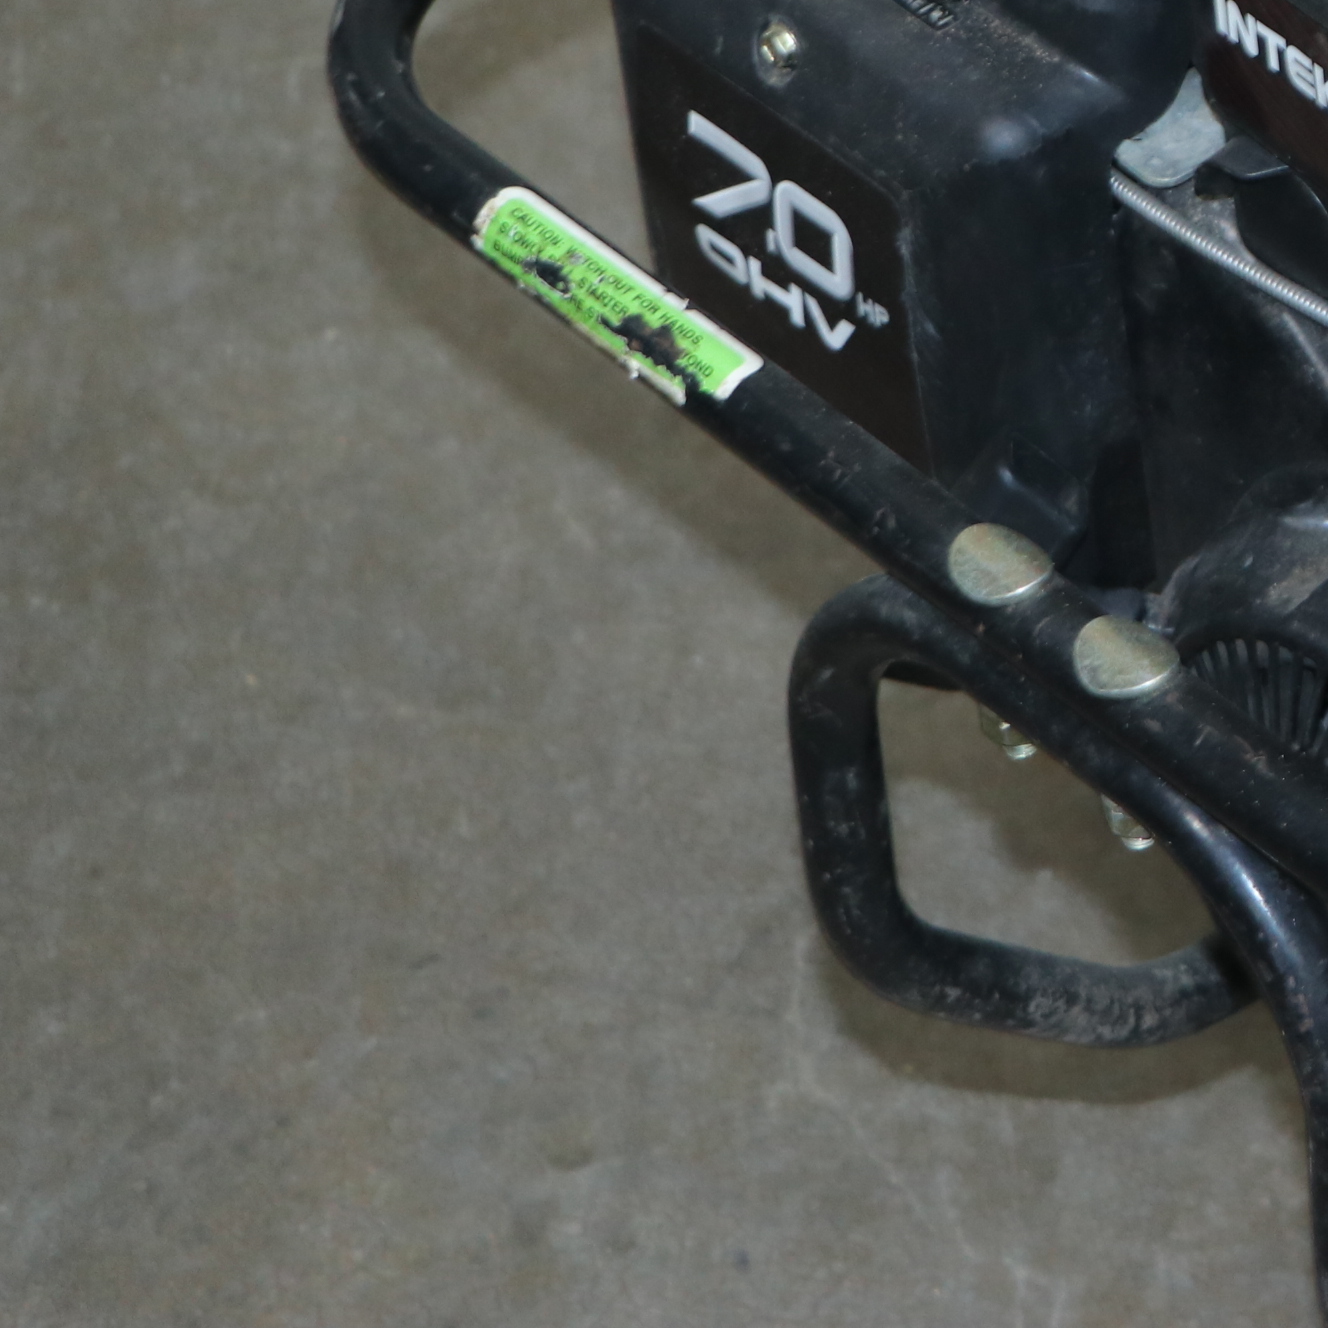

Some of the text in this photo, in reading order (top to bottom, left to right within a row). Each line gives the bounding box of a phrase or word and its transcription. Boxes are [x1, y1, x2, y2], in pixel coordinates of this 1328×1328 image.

[511, 206, 564, 250] CAUTION:
[636, 291, 660, 314] FOR
[660, 312, 703, 346] HANDS
[578, 276, 630, 316] STARTER
[695, 223, 856, 351] OHV
[855, 291, 890, 328] HP
